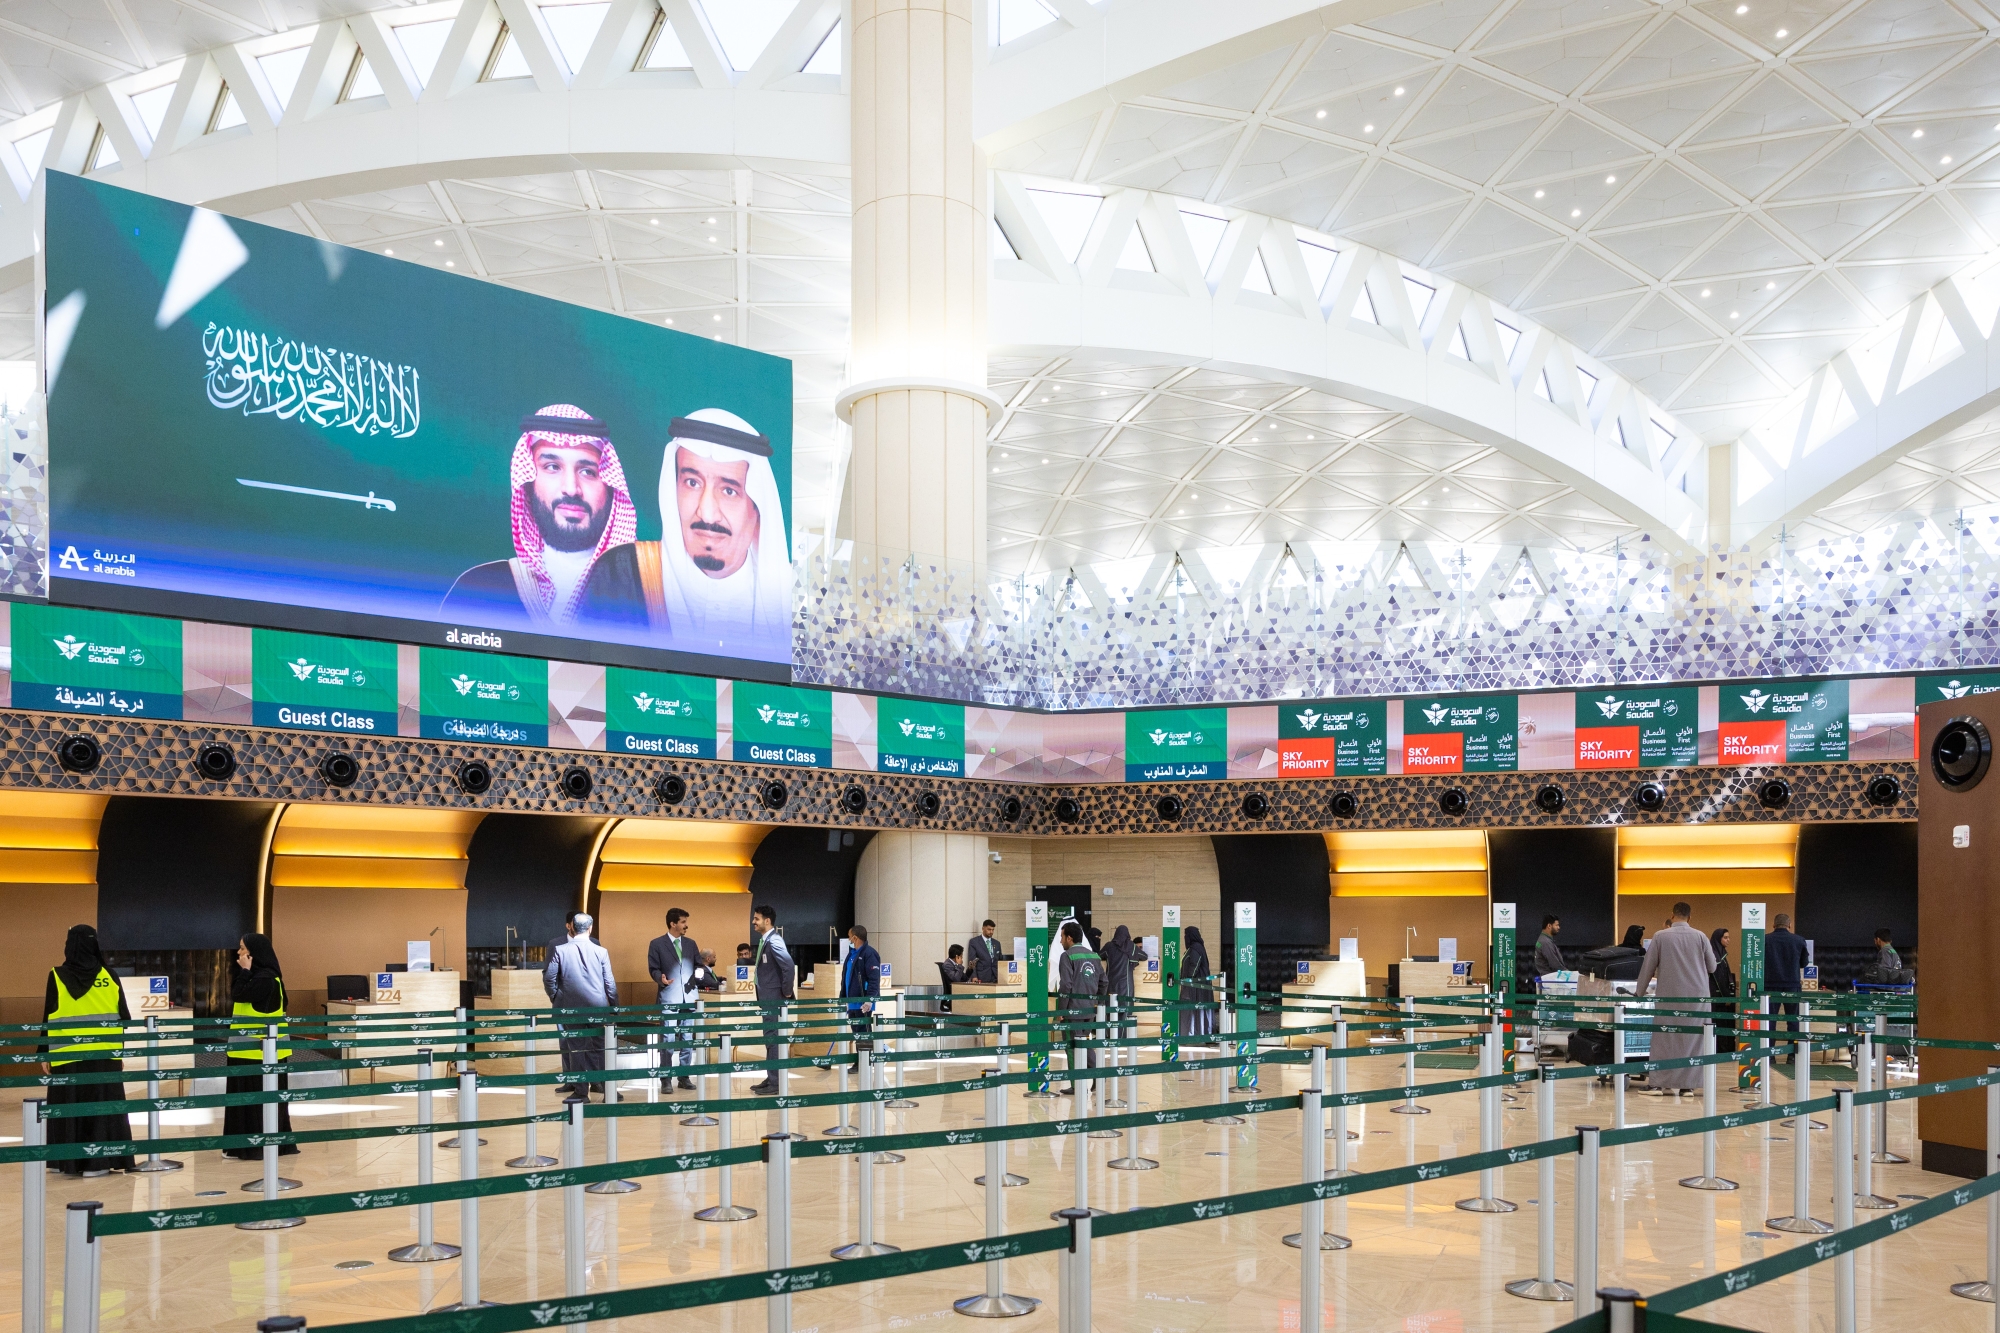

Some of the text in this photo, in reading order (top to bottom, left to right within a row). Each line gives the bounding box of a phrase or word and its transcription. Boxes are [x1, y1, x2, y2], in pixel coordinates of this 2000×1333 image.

[93, 549, 136, 564] العربية
[93, 563, 136, 577] al arabia
[446, 628, 502, 648] al arabia
[88, 643, 126, 656] السعودية
[88, 654, 119, 665] Saudia
[317, 665, 349, 676] السعودية
[317, 675, 344, 685] Saudia
[477, 681, 505, 691] السعودية
[477, 690, 501, 699] Saudia
[1772, 692, 1808, 705] السعودية
[55, 687, 144, 713] درجة الضيافة
[655, 697, 679, 709] السعودية
[1626, 699, 1660, 711] السعودية
[655, 707, 675, 716] Saudia
[1450, 706, 1482, 718] السعودية
[1772, 704, 1802, 713] Saudia
[278, 707, 374, 730] Guest Class
[777, 709, 799, 720] السعودية
[1323, 712, 1353, 723] السعودية
[1626, 709, 1654, 719] Saudia
[777, 718, 795, 727] Saudia
[1323, 722, 1348, 731] Saudia
[1450, 717, 1477, 726] Saudia
[1825, 720, 1843, 732] الأولى
[1643, 727, 1666, 738] الأعمال
[1675, 726, 1693, 737] الأولى
[1790, 722, 1814, 733] الأعمال
[1466, 733, 1488, 744] الأعمال
[1497, 733, 1513, 743] الأولى
[1723, 736, 1748, 746] SKY
[1789, 732, 1815, 740] Business
[625, 735, 699, 755] Guest Class
[1338, 739, 1358, 749] الأعمال
[1366, 738, 1382, 748] الأولى
[1580, 741, 1603, 751] SKY
[750, 745, 816, 763] Guest Class
[1282, 751, 1303, 760] SKY
[1408, 747, 1429, 756] SKY
[1580, 750, 1633, 760] PRIORITY
[1723, 745, 1780, 756] PRIORITY
[884, 754, 958, 773] الأشخاص ذوي الإعاقة
[1282, 760, 1330, 769] PRIORITY
[1408, 756, 1457, 765] PRIORITY
[1144, 765, 1207, 779] المشرف المناوب
[1036, 944, 1044, 967] مخرج
[1008, 974, 1022, 983] 228
[1143, 972, 1159, 981] 229
[1298, 974, 1316, 983] 230
[1446, 976, 1465, 985] 231
[736, 981, 754, 991] 226
[881, 977, 891, 987] 27
[377, 989, 402, 1001] 224
[141, 995, 169, 1008] 223
[174, 1220, 198, 1228] Saudia
